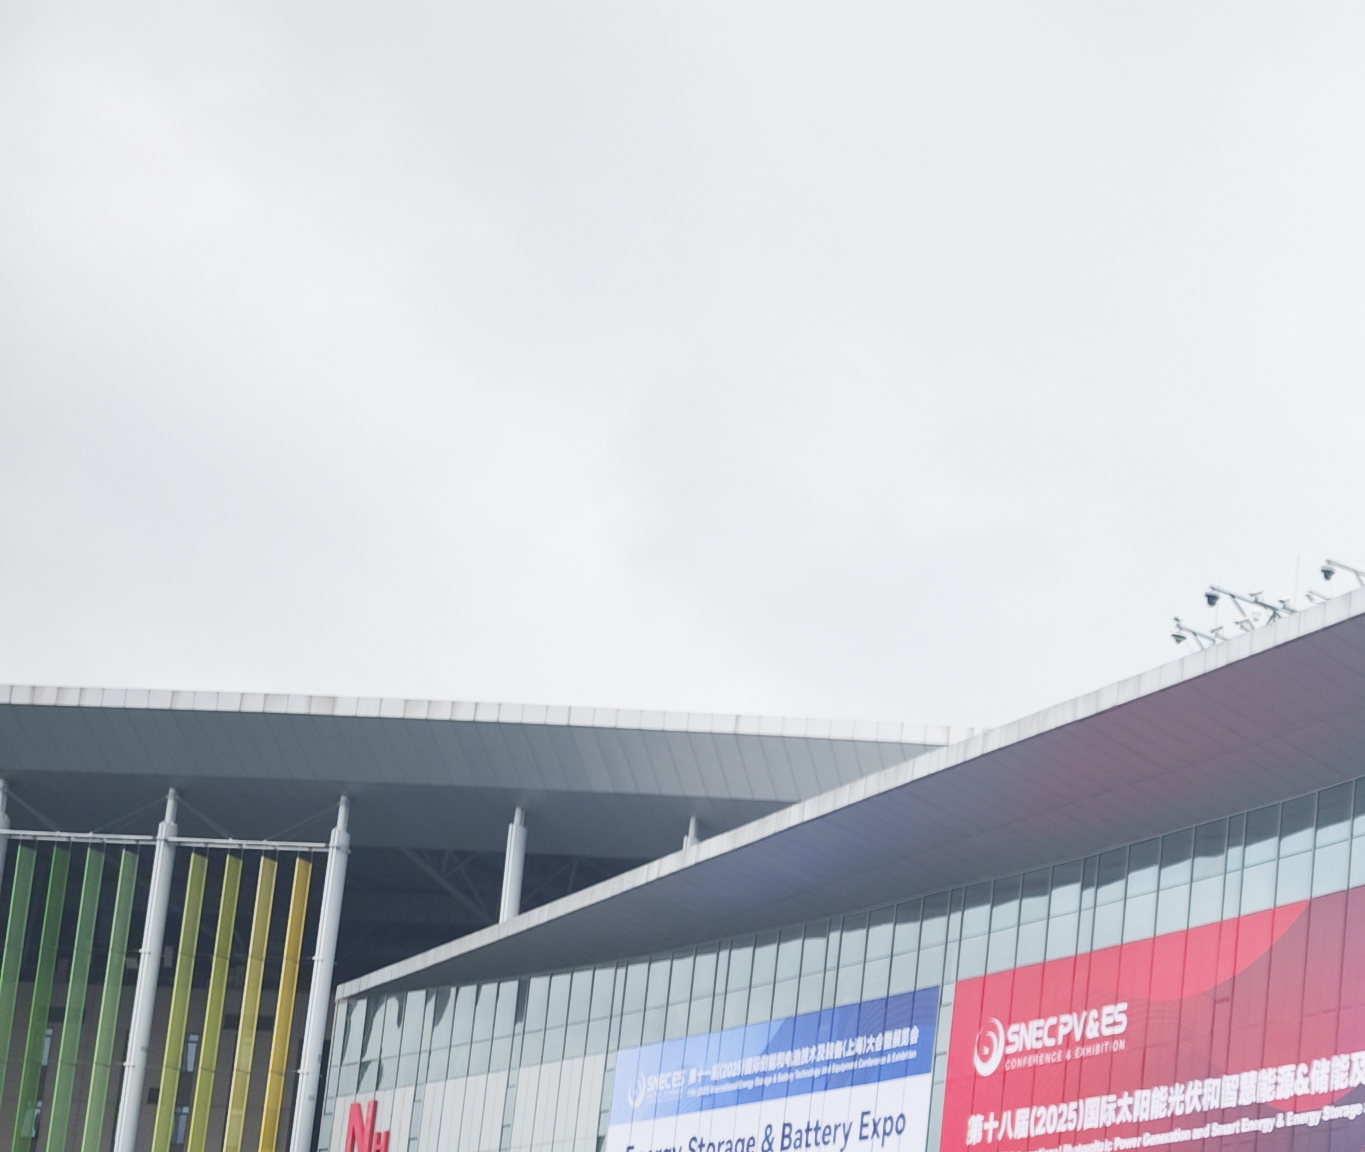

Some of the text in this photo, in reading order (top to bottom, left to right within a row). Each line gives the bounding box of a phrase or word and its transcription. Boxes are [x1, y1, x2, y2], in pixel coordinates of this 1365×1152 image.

[1005, 1050, 1062, 1072] CONFERENCE
[1074, 1039, 1126, 1060] EXHIBITION
[780, 1117, 854, 1151] Battery
[858, 1110, 907, 1147] Expo
[1114, 1137, 1142, 1151] Power
[1192, 1123, 1210, 1139] and
[1211, 1120, 1240, 1138] Smart
[1241, 1116, 1275, 1134] Energy
[1276, 1113, 1285, 1128] &
[1286, 1109, 1322, 1127] Energy
[1322, 1104, 1363, 1121] Storage
